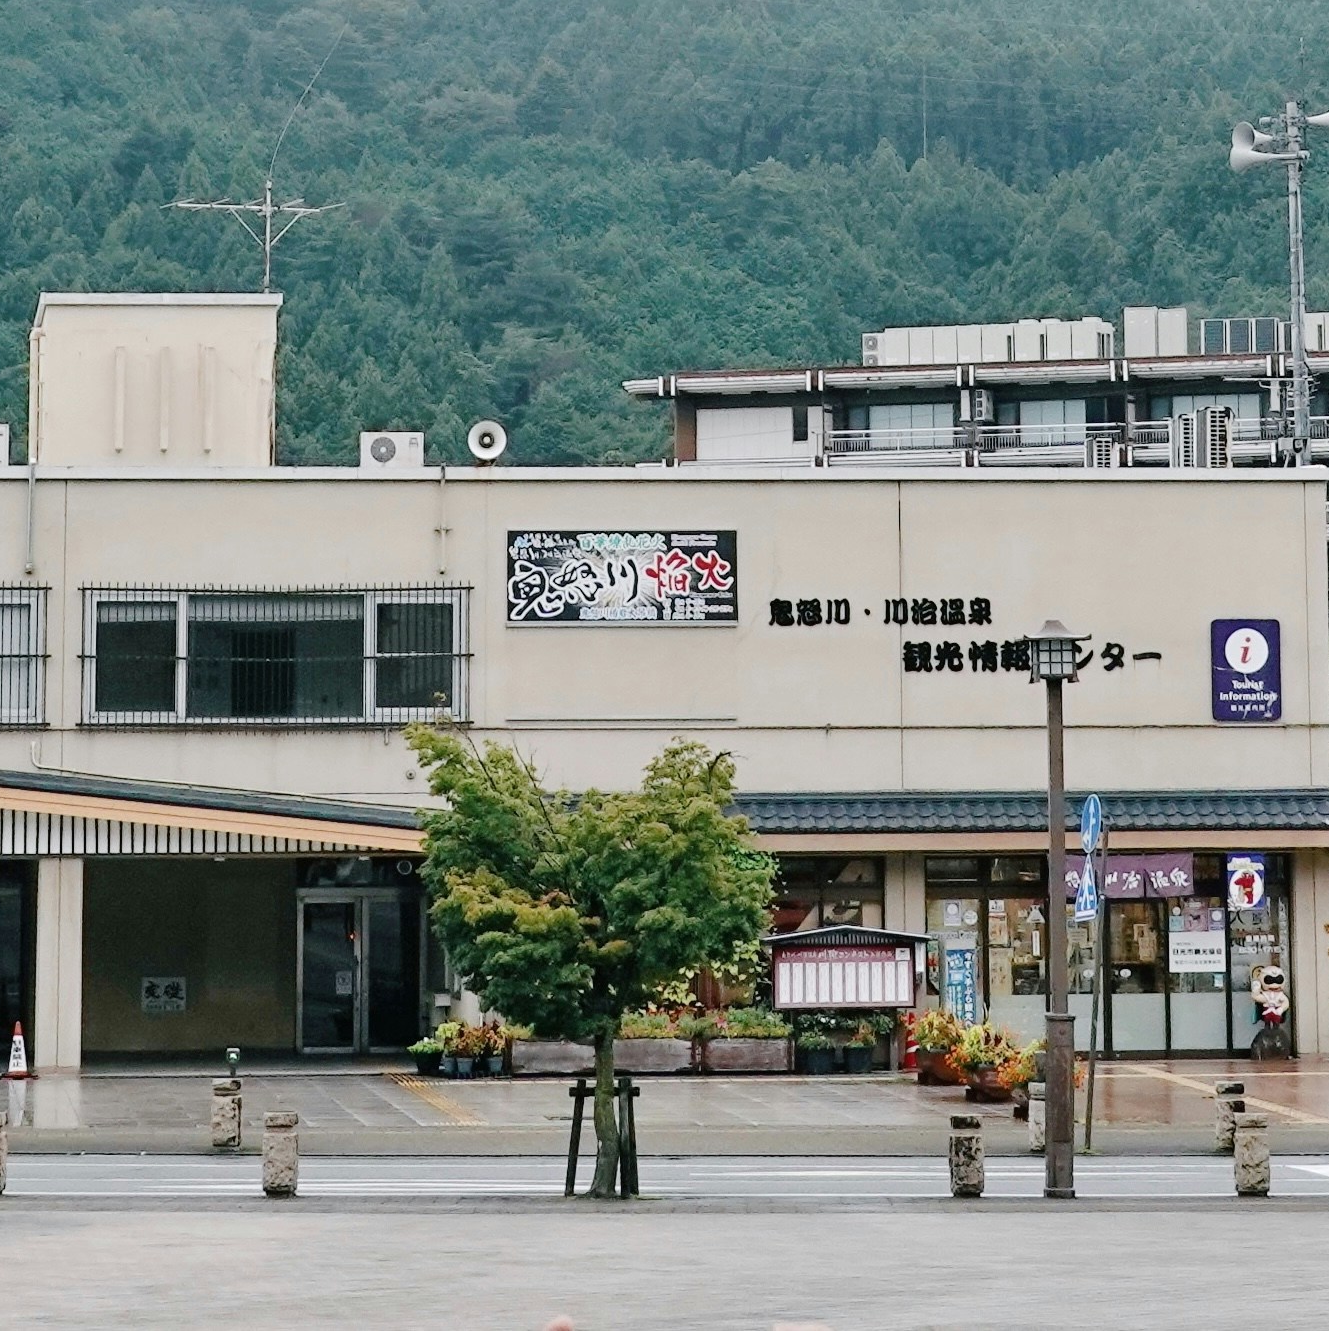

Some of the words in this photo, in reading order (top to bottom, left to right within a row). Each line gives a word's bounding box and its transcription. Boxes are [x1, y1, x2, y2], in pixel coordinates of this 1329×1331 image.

[768, 597, 993, 626] 鬼怒川・川治温泉
[902, 640, 1162, 672] 観光情報ンター
[1232, 680, 1264, 690] Tourist
[1219, 691, 1278, 701] Information
